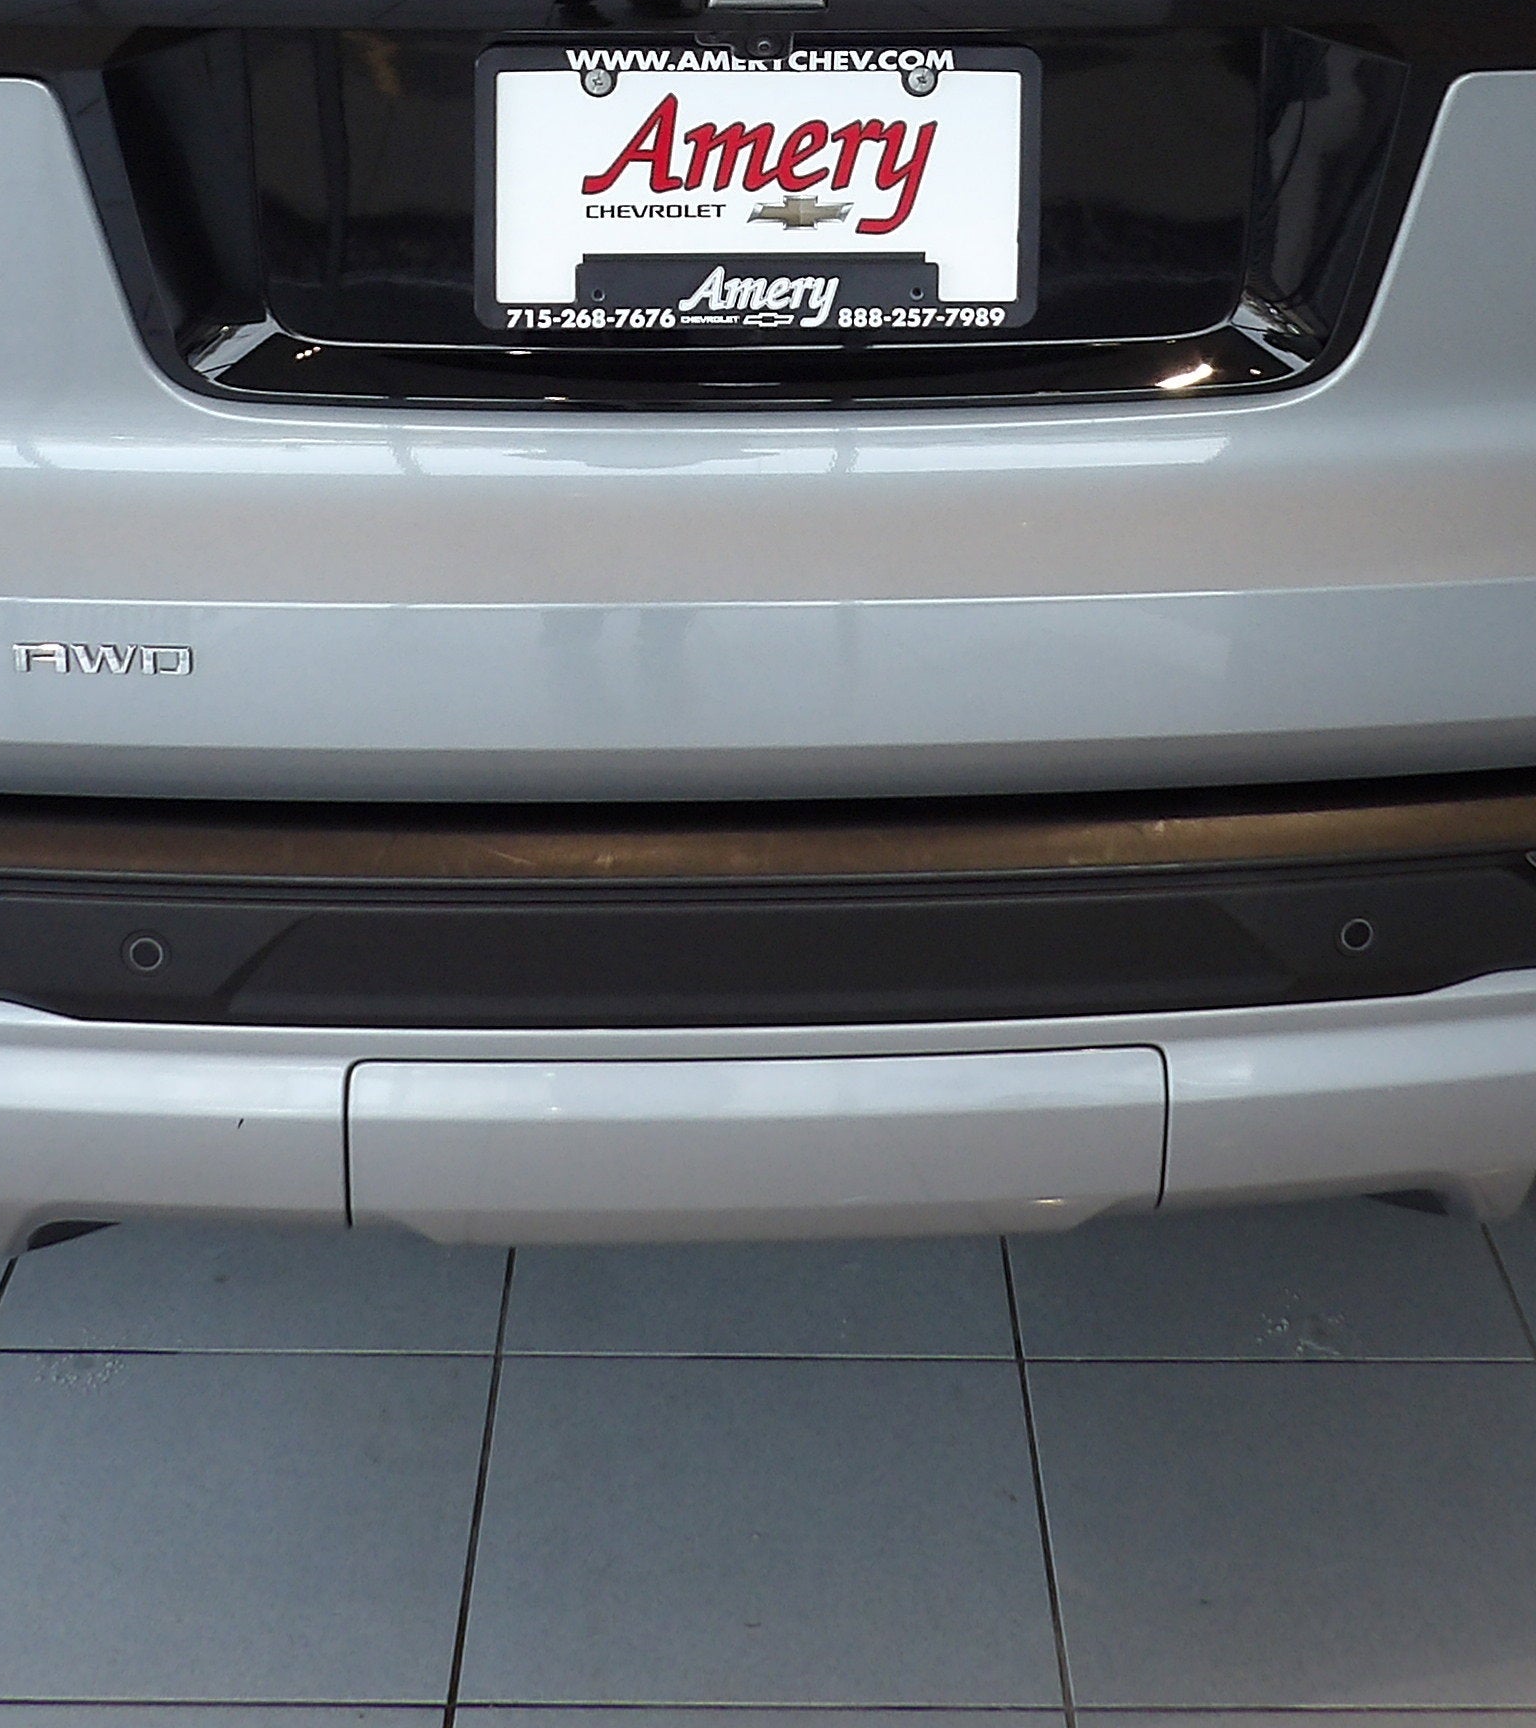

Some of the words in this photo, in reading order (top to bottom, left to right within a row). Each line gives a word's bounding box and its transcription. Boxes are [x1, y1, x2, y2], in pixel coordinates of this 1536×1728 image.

[581, 92, 938, 235] Amery
[585, 204, 727, 219] CHEVROLET
[678, 265, 840, 328] Amery
[506, 307, 676, 329] 715-268-7676
[837, 306, 1006, 329] 888-257-7989
[13, 642, 195, 676] AWD
